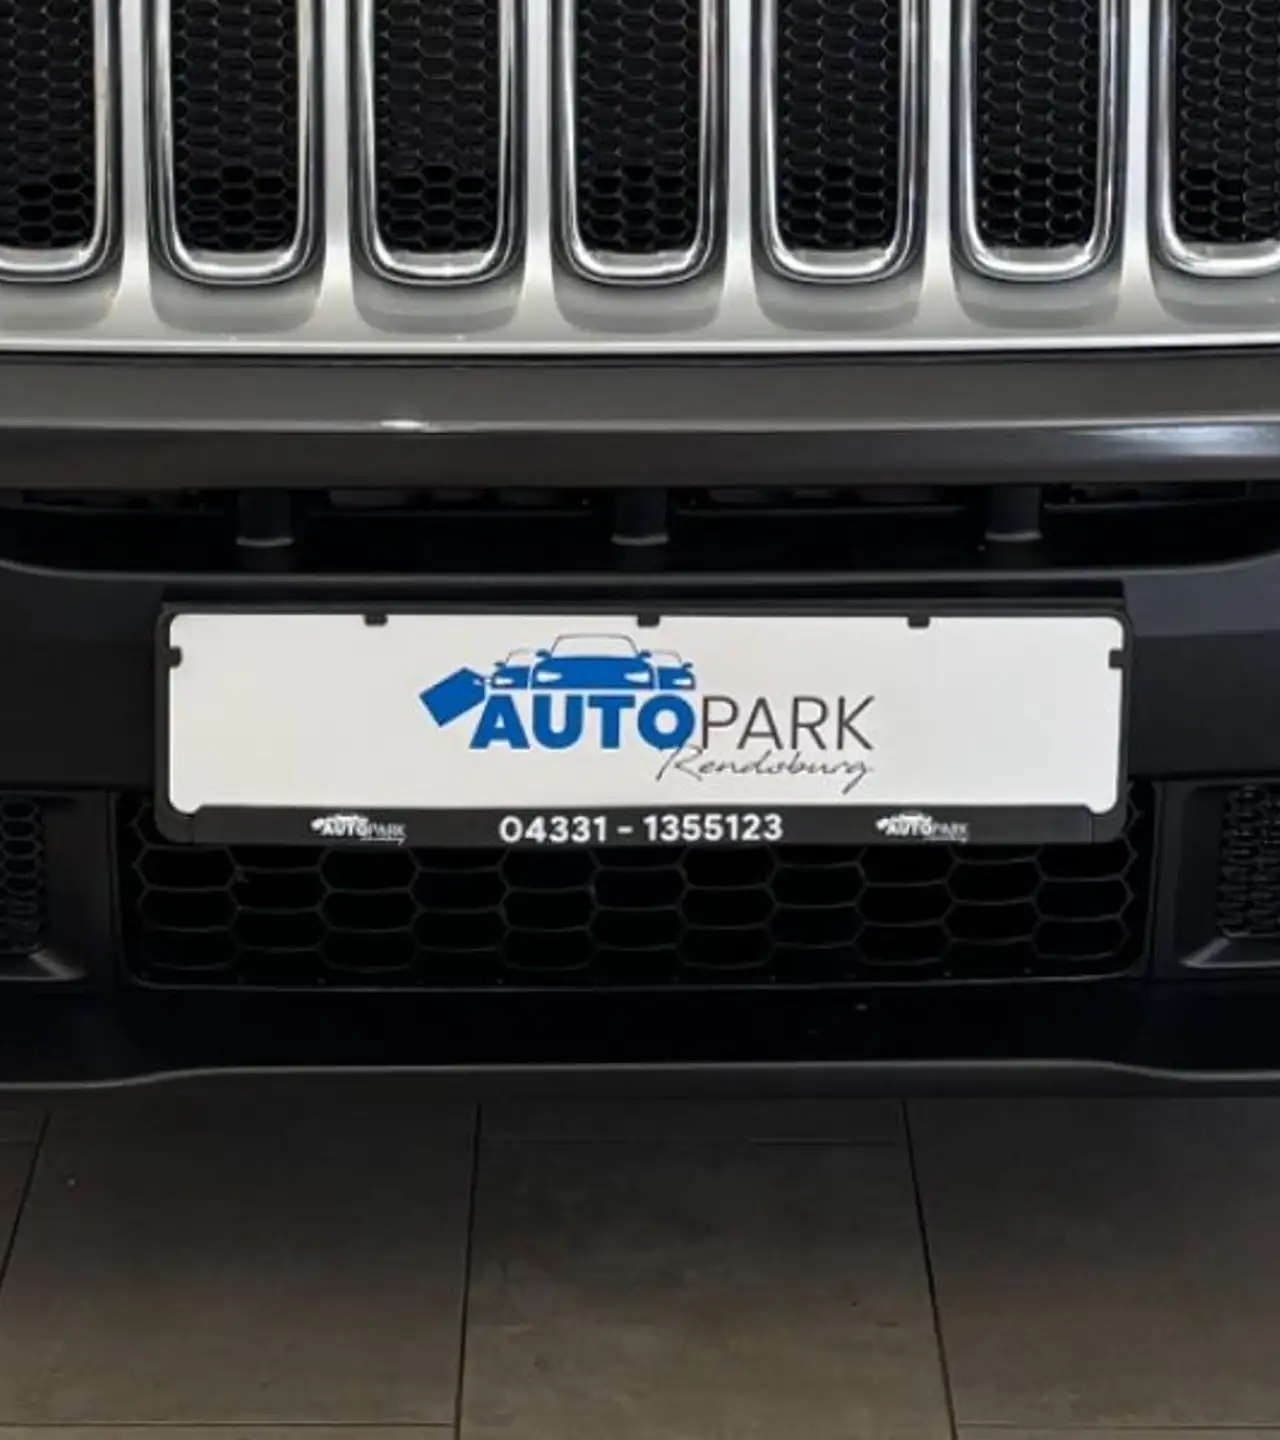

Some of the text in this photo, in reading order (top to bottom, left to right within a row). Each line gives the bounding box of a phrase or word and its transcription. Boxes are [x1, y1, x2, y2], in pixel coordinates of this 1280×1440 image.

[469, 694, 876, 750] AUTOPARK
[498, 813, 783, 843] 04331 - 1355123
